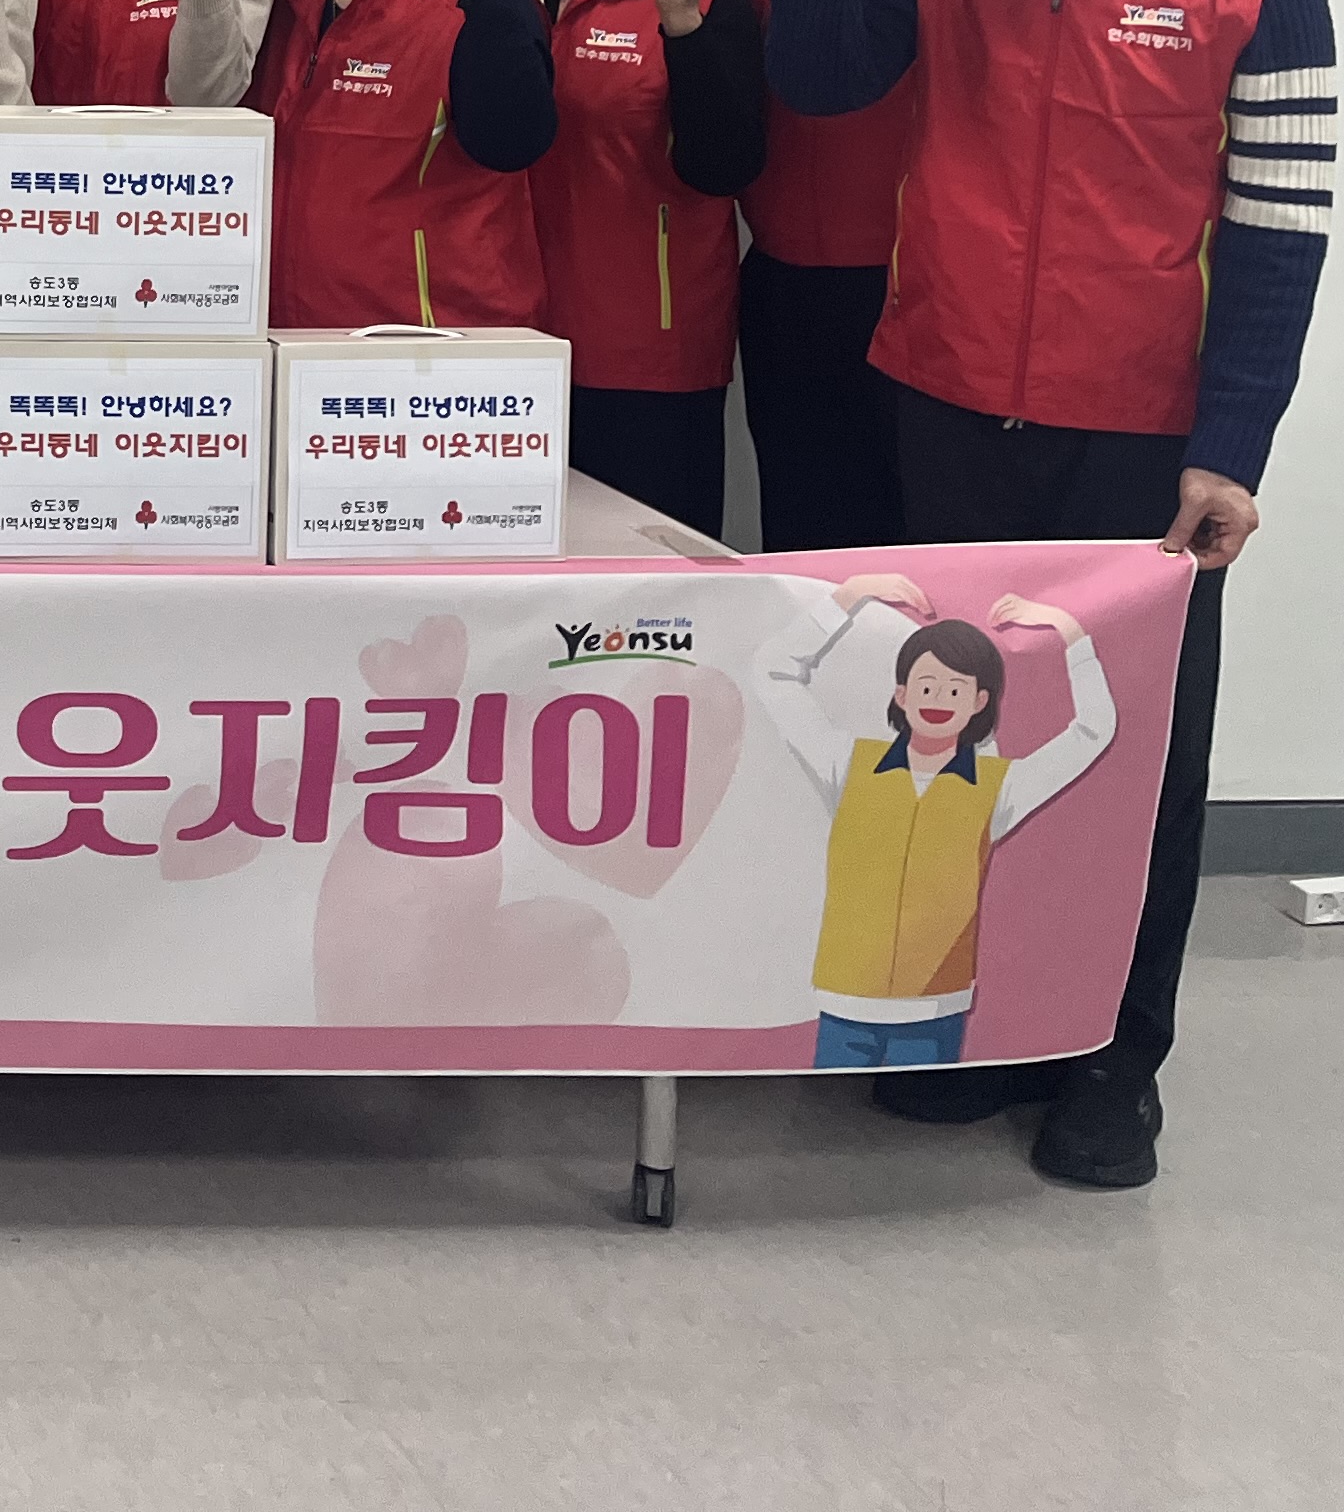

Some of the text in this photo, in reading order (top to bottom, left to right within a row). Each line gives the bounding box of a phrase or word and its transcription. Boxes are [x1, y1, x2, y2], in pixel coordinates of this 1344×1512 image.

[10, 171, 235, 197] 똑똑똑! 안녕하세요?
[115, 209, 249, 237] 이웃지킴이
[28, 275, 80, 291] 송도3동
[9, 394, 232, 419] 똑똑똑! 안녕하세요?
[320, 395, 535, 420] 똑똑똑! 안녕하세요?
[114, 431, 248, 459] 이웃지킴이
[304, 432, 550, 461] 우리동네 이웃지킴이
[29, 498, 81, 513] 송도3동
[340, 500, 389, 515] 송도3동
[303, 516, 425, 532] 지역사회보장협의체
[636, 617, 693, 628] Better life
[555, 622, 693, 661] Yeonsu
